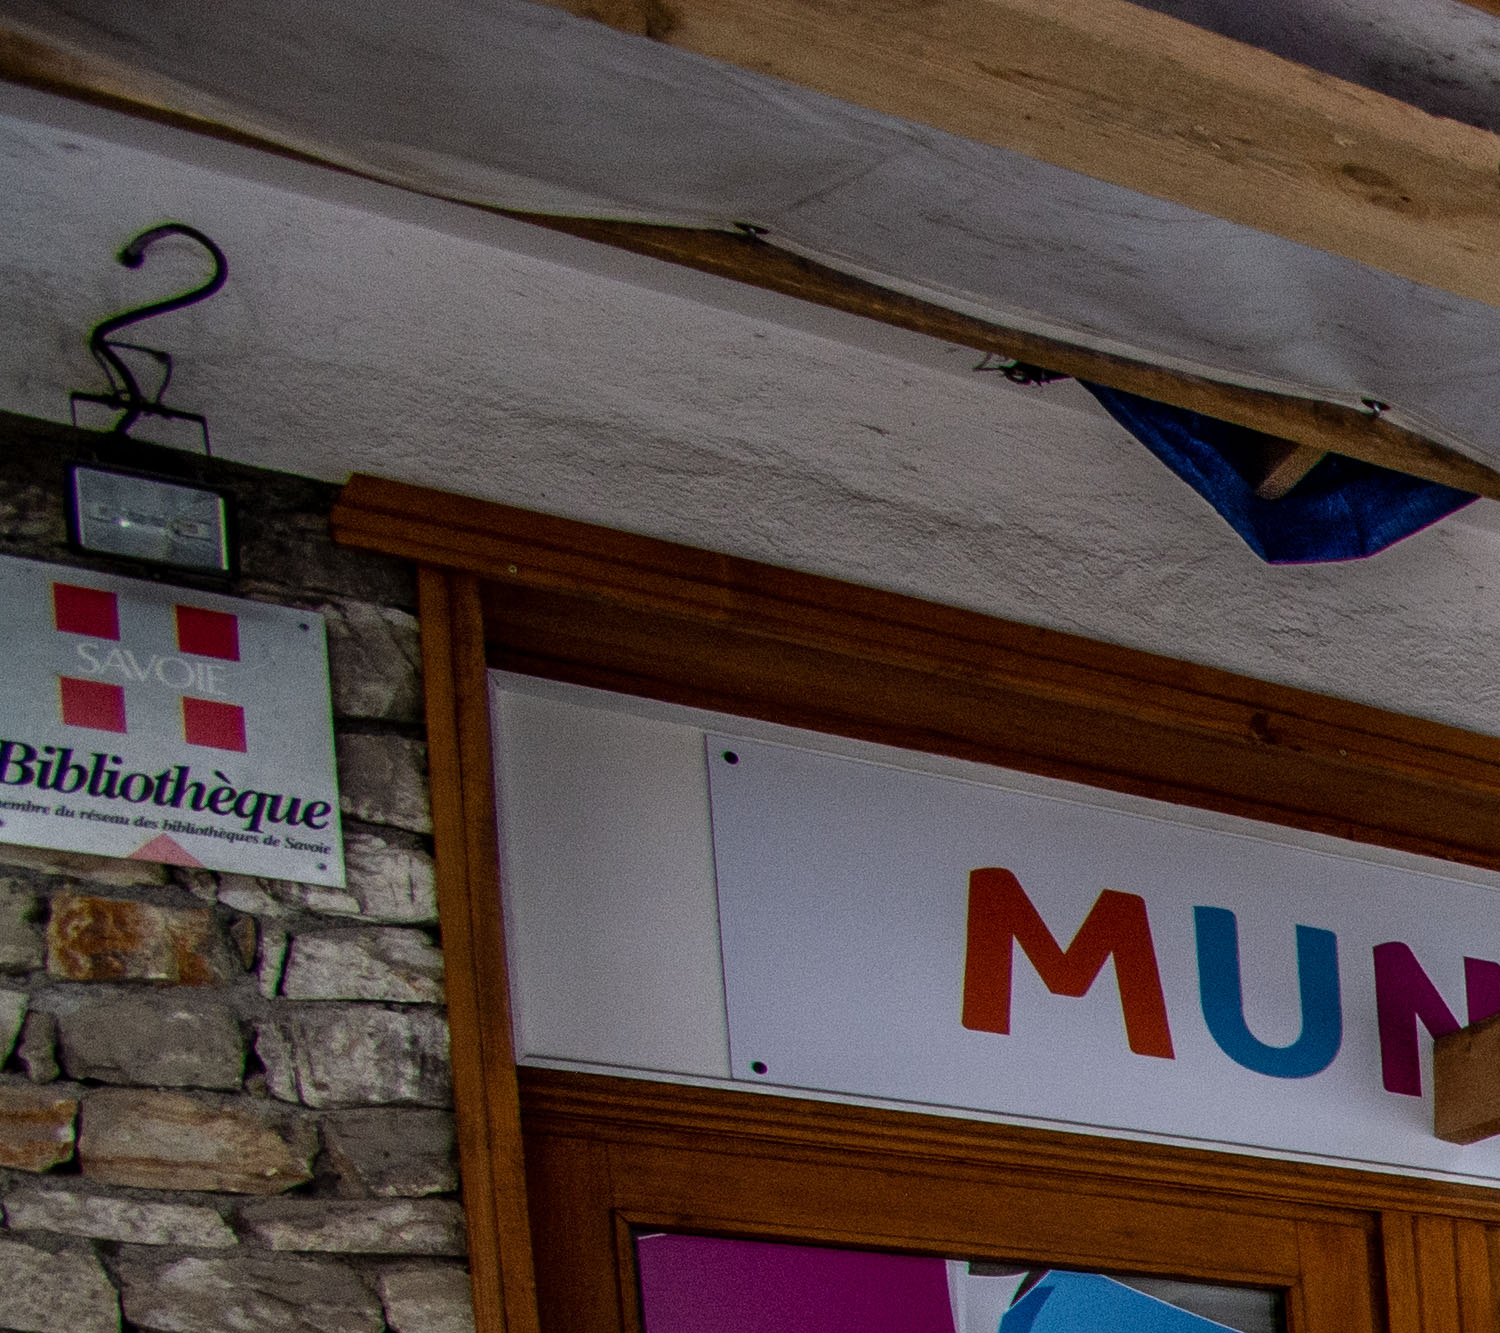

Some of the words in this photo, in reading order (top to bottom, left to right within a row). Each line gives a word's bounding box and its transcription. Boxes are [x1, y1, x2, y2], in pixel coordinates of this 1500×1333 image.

[77, 642, 227, 696] SAVOIE
[0, 739, 332, 833] Bibliothèque
[0, 801, 50, 815] embre
[55, 805, 75, 818] du
[79, 810, 130, 825] réseau
[133, 816, 158, 829] des
[162, 819, 259, 844] bibliothèques
[263, 833, 281, 847] de
[285, 836, 332, 855] Savoie
